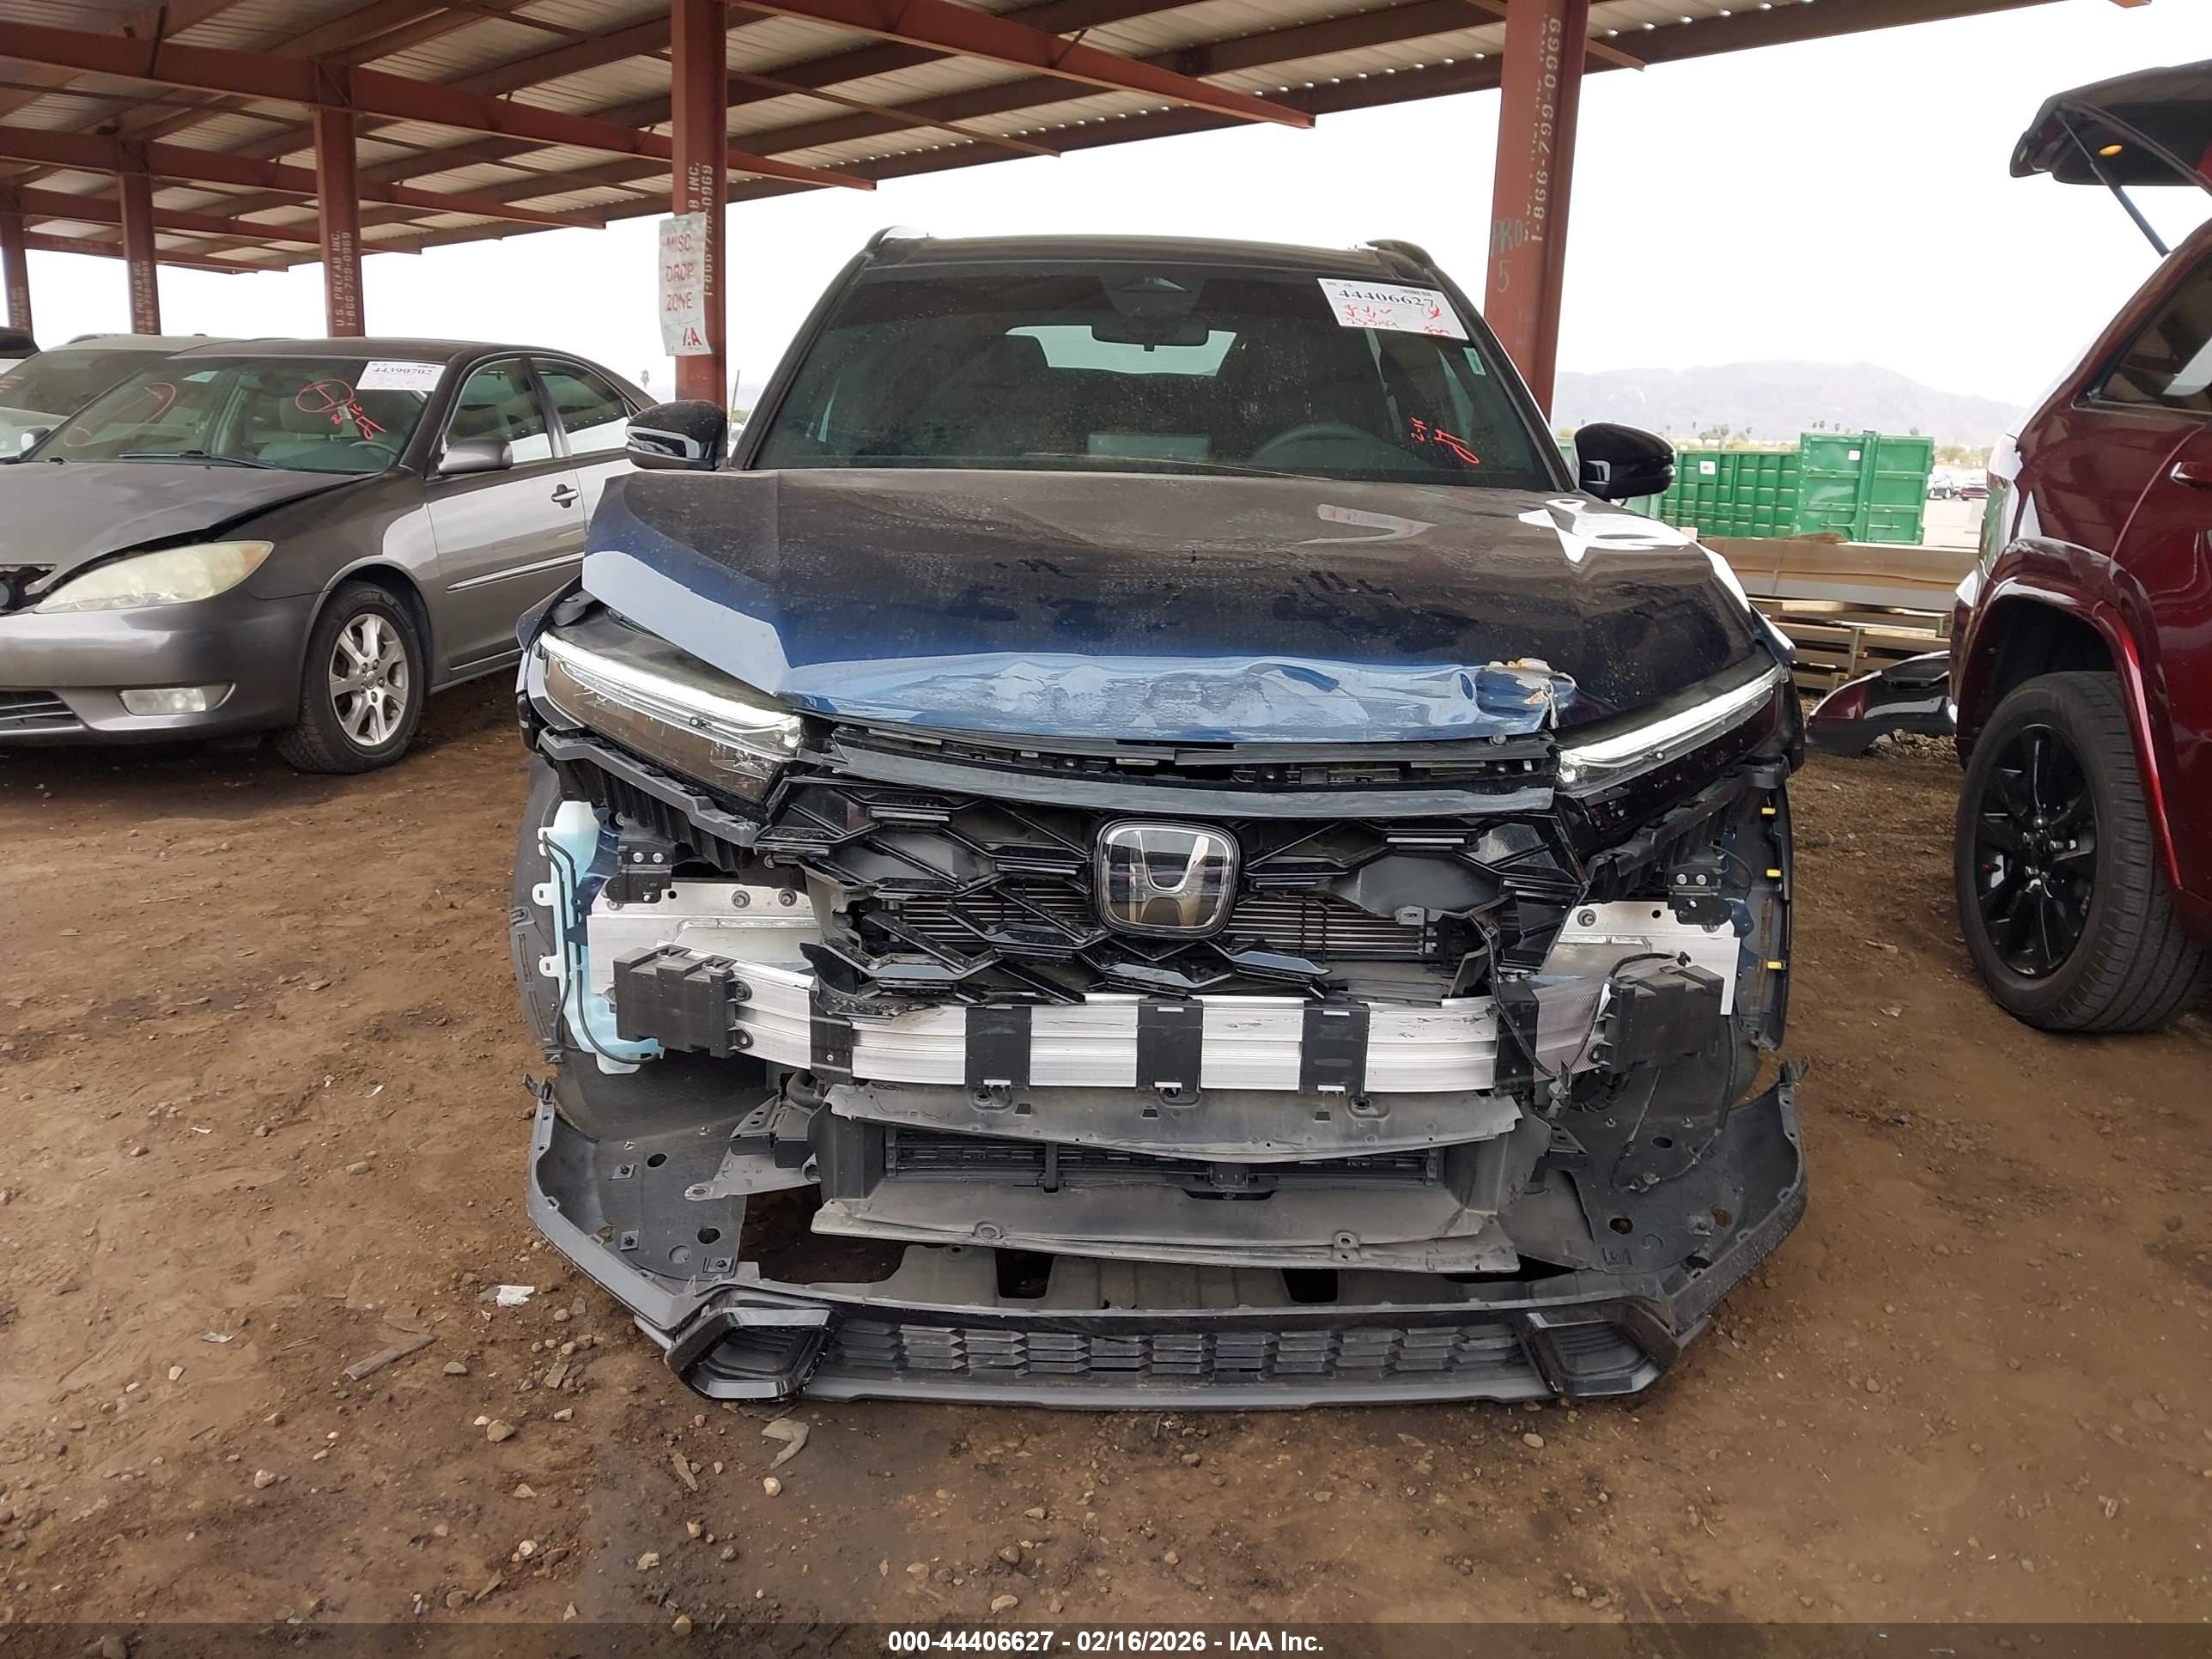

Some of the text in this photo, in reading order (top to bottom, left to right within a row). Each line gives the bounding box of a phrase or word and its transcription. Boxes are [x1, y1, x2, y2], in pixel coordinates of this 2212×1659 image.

[665, 263, 695, 283] DROP
[666, 292, 693, 312] ZONE
[1339, 289, 1434, 307] 44406627
